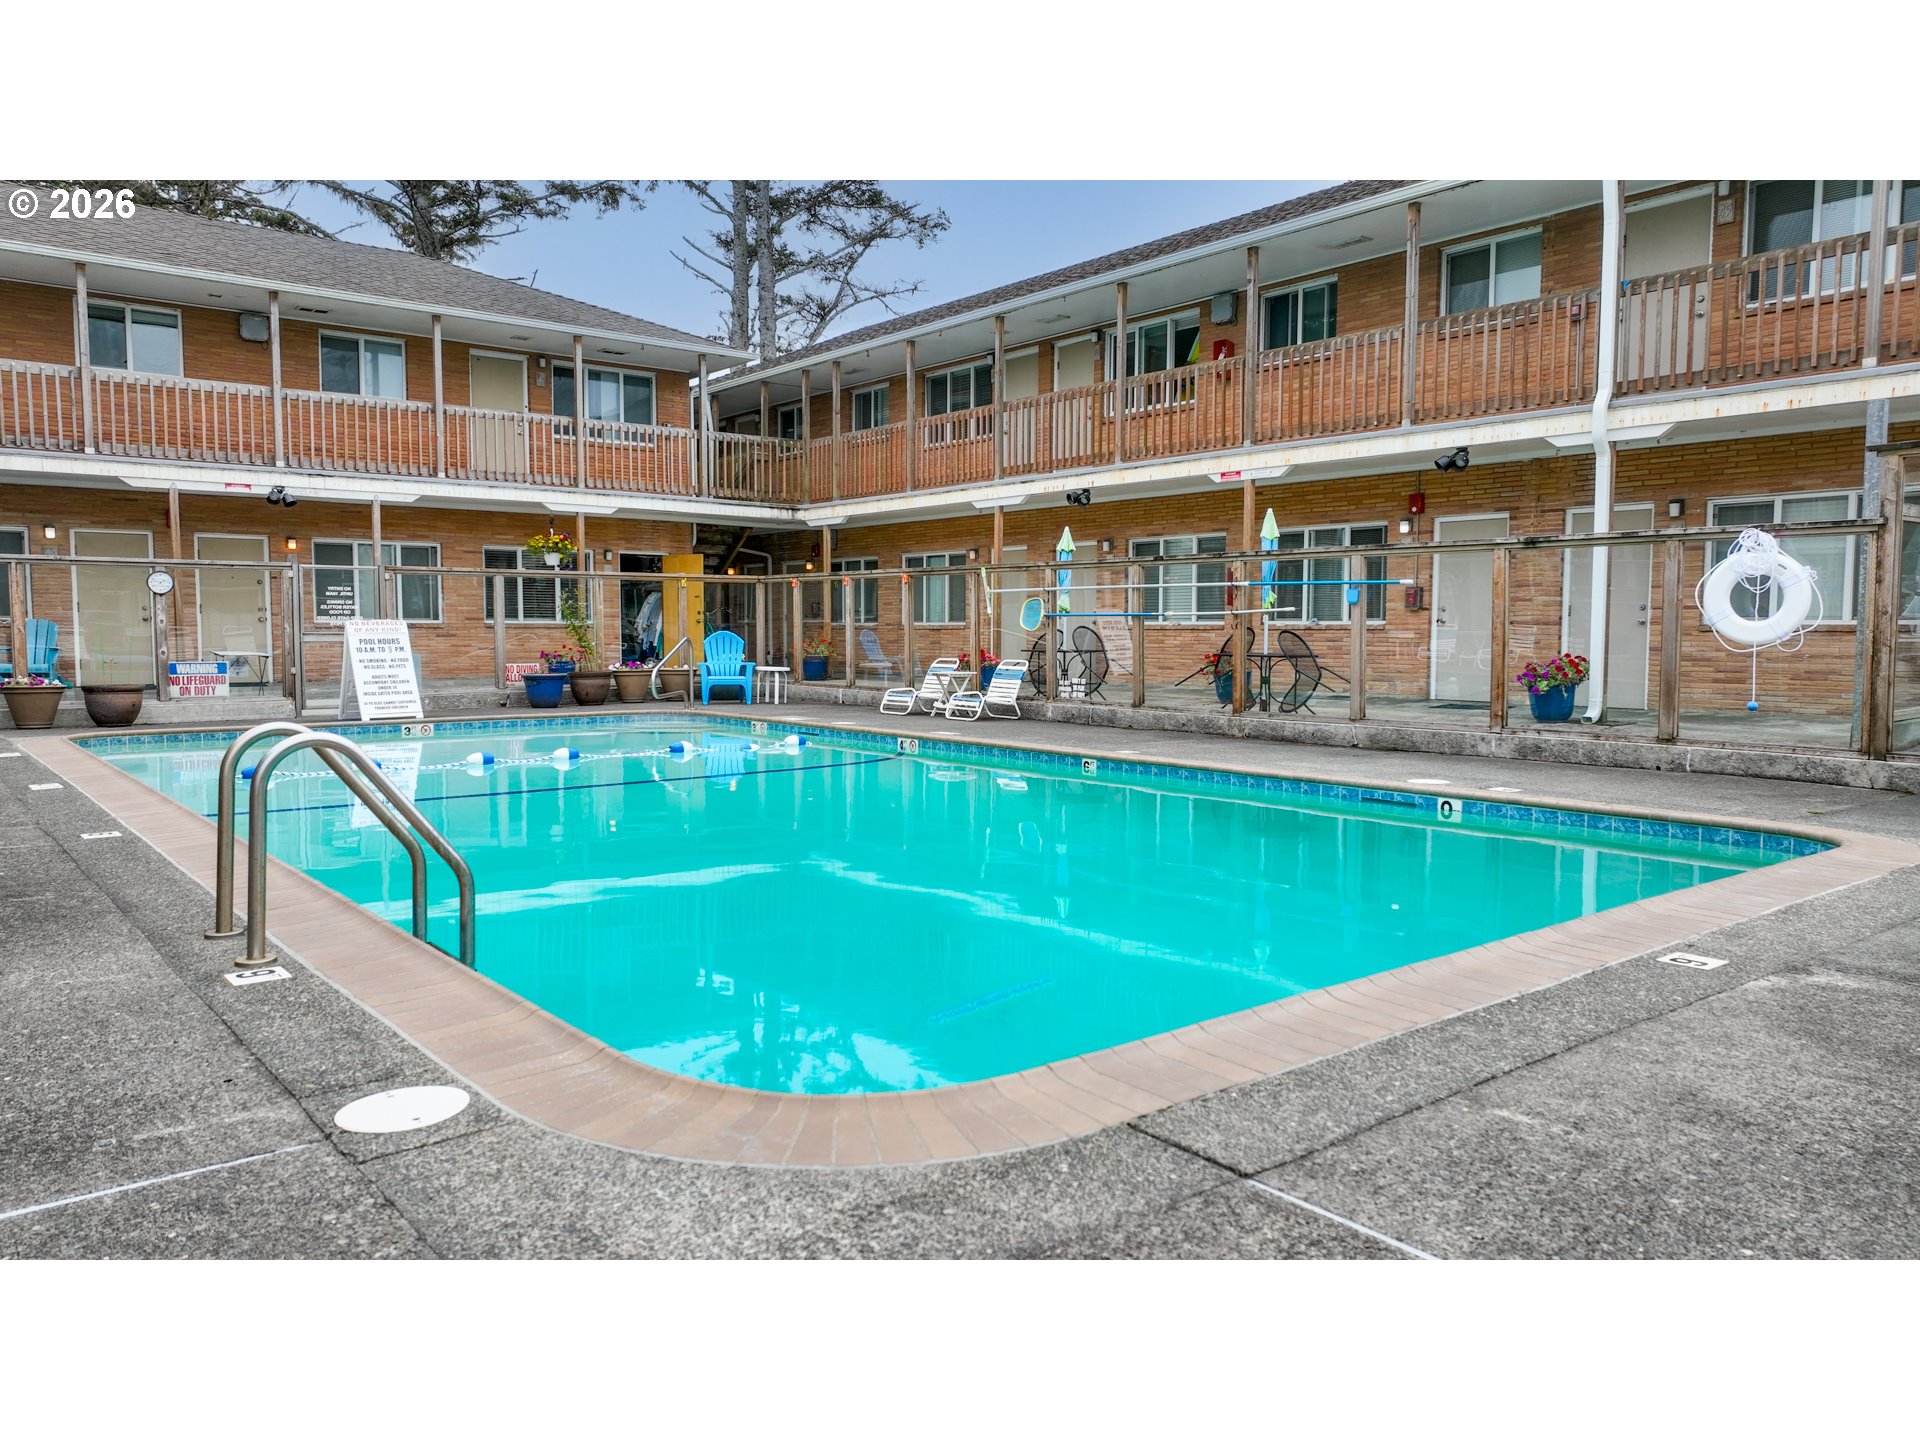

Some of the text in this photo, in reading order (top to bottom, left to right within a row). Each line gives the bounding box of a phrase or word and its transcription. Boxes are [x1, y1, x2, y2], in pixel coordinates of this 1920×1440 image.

[175, 663, 218, 674] WARNING
[505, 664, 538, 674] NO DIVING
[169, 675, 226, 686] NO LIFEGUARD
[179, 686, 216, 696] ON DUTY
